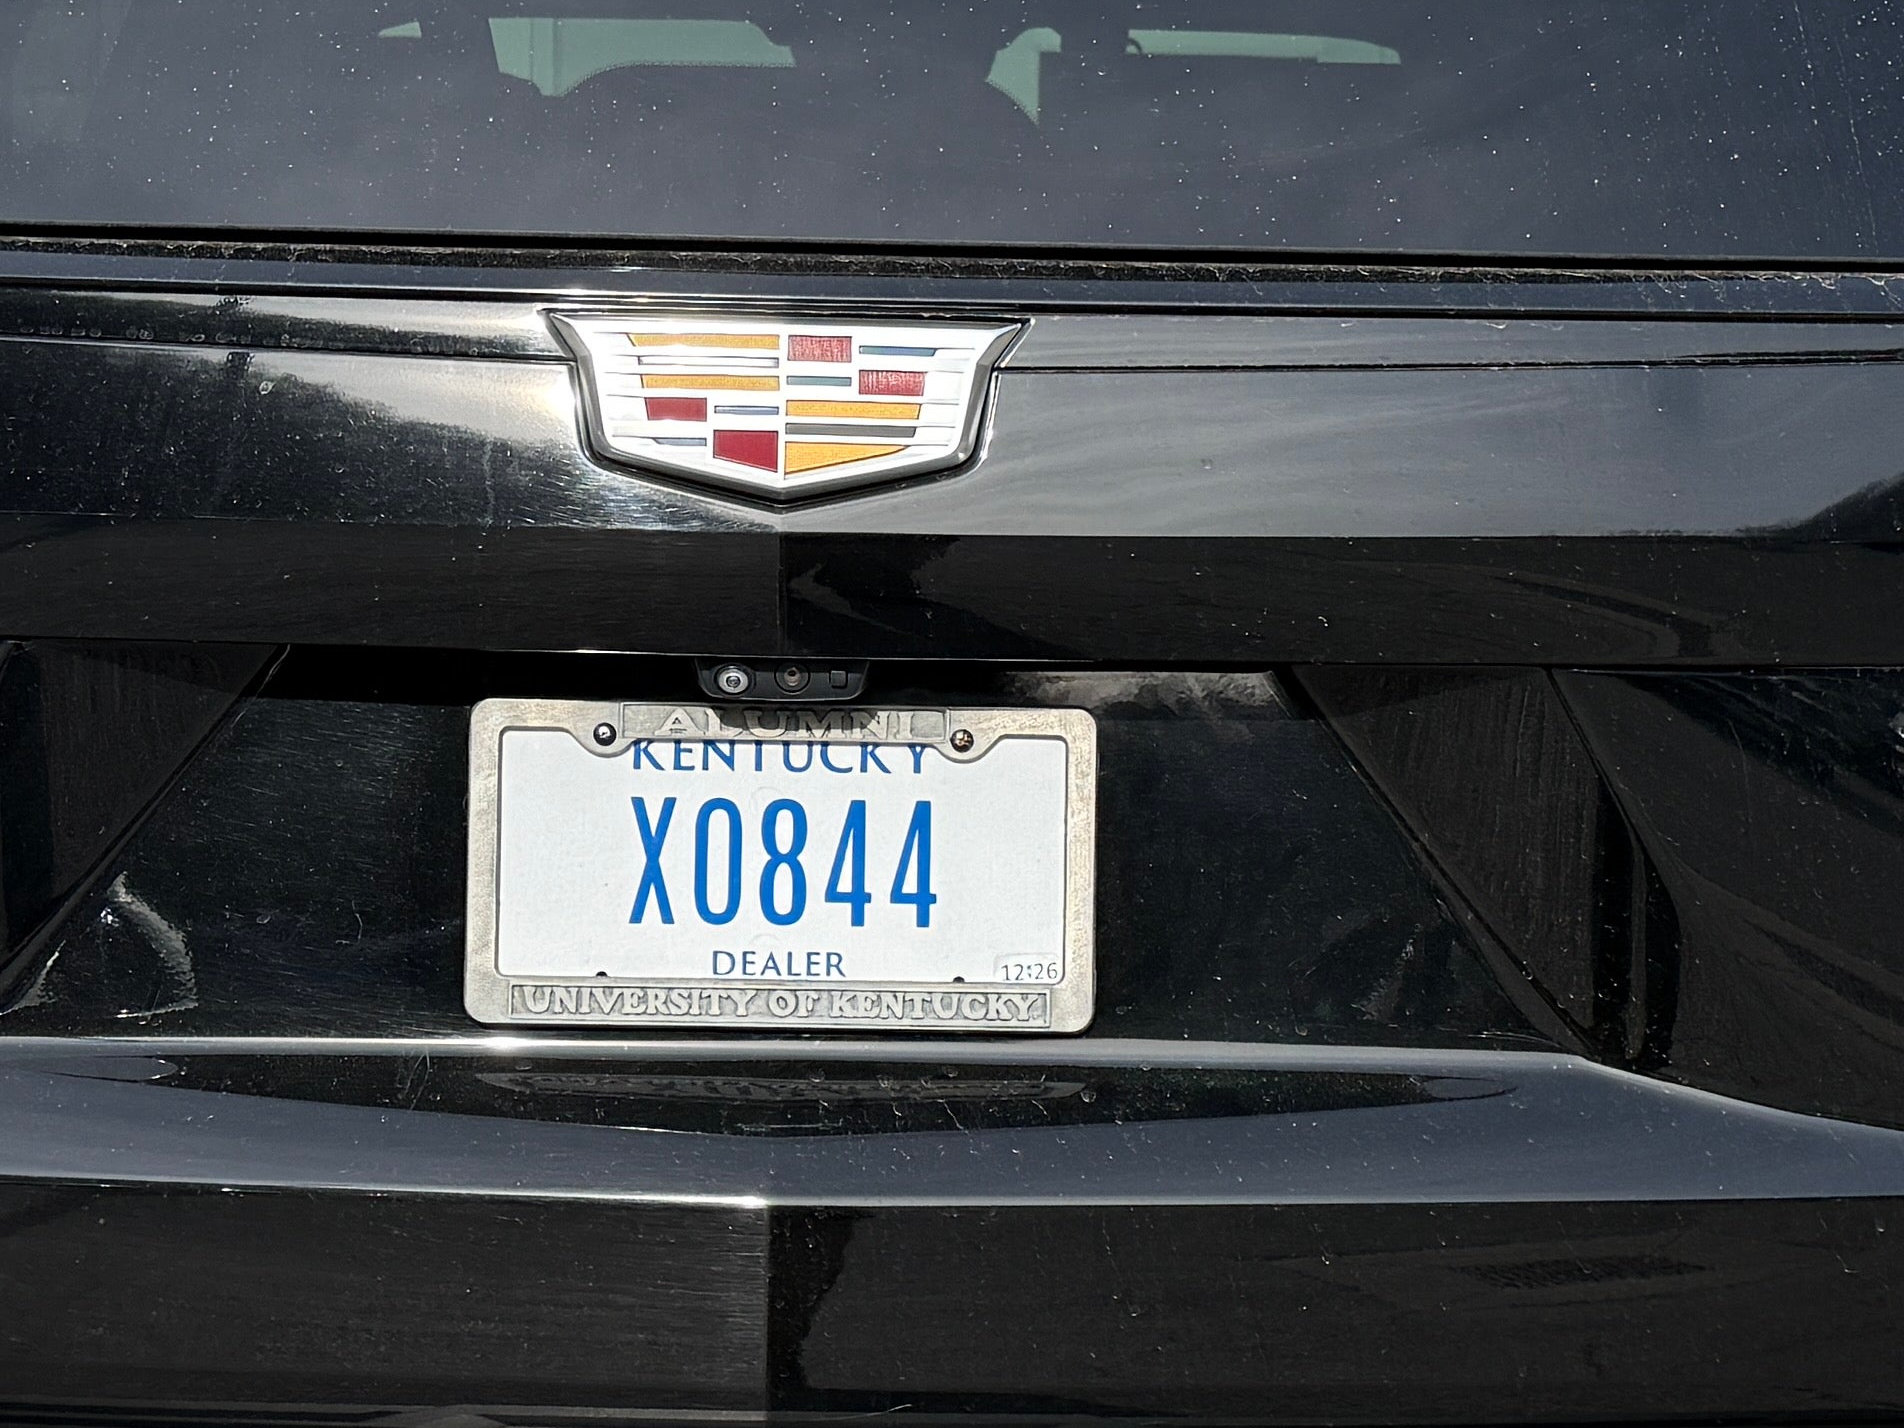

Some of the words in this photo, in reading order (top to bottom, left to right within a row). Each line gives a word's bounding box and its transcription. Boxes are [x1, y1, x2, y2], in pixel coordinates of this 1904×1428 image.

[653, 708, 916, 739] ALUMNI
[631, 740, 930, 774] KENTUCKY
[629, 796, 937, 928] X0844
[711, 951, 846, 978] DEALER
[524, 988, 757, 1017] UNIVERSITY
[769, 991, 816, 1017] OF
[830, 991, 1037, 1021] KENTUCKY
